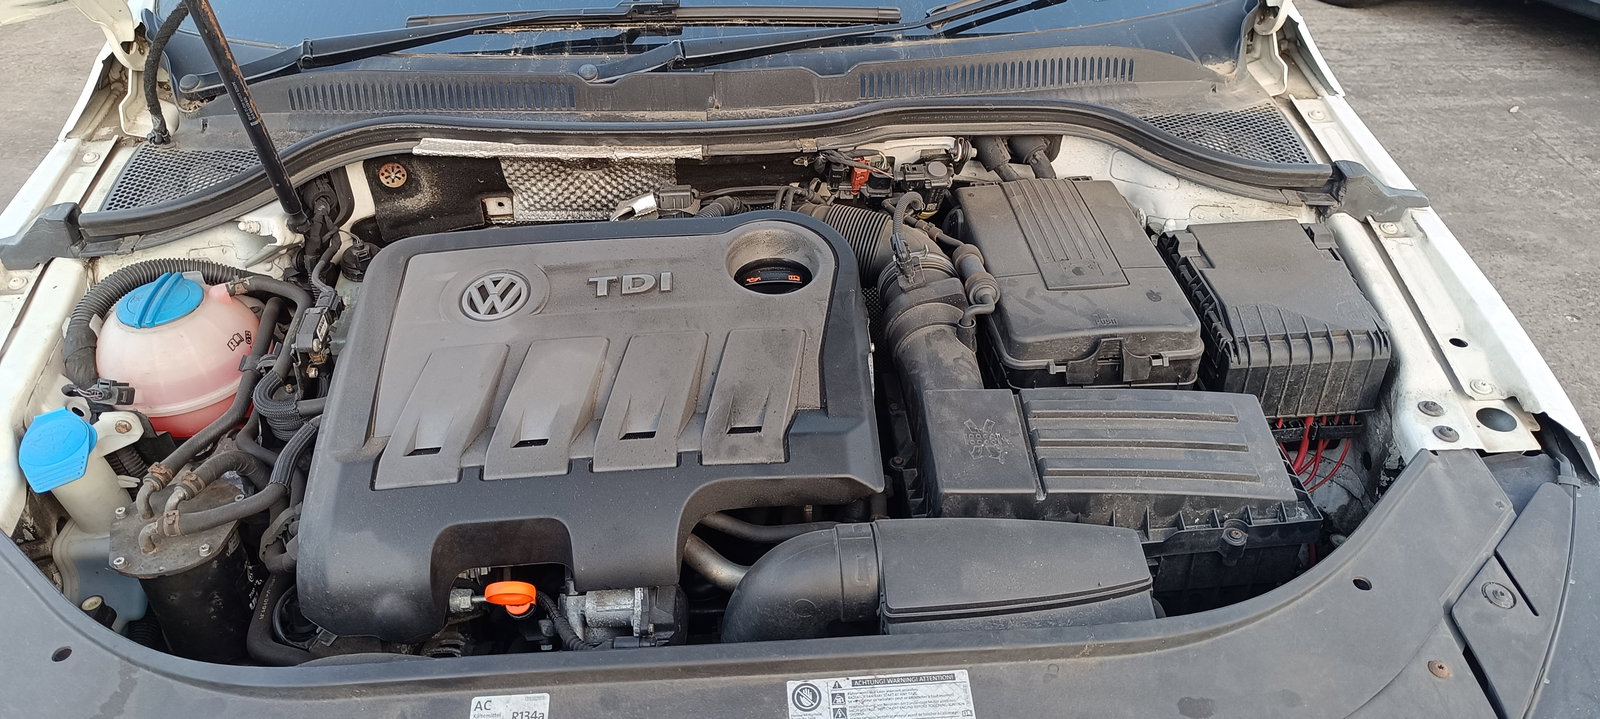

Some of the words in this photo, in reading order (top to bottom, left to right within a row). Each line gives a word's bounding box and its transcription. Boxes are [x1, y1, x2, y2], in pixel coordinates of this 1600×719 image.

[588, 271, 674, 298] TDI
[461, 271, 530, 321] VW
[474, 700, 492, 711] AC
[512, 711, 545, 719] R134a
